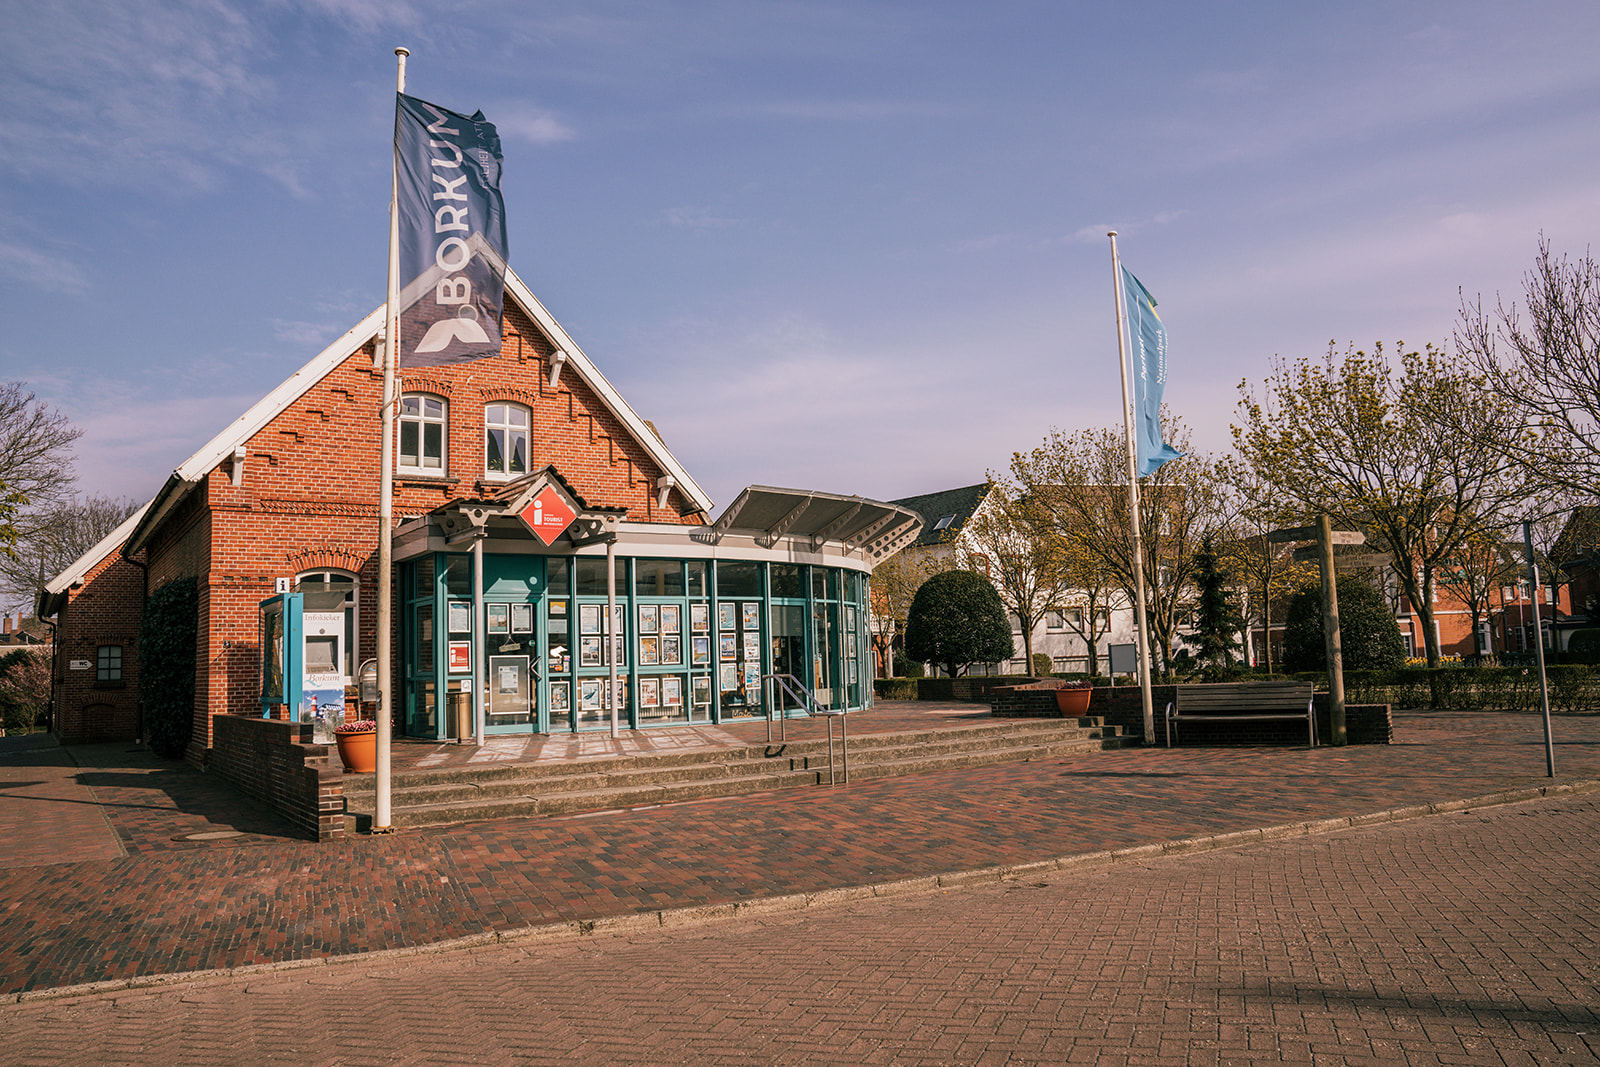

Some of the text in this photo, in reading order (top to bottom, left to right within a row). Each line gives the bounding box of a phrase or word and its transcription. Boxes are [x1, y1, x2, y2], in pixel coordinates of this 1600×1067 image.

[422, 102, 472, 305] BORKUM
[1138, 335, 1147, 382] Partner
[1156, 329, 1164, 384] Nationalpark
[308, 672, 340, 682] Borkum
